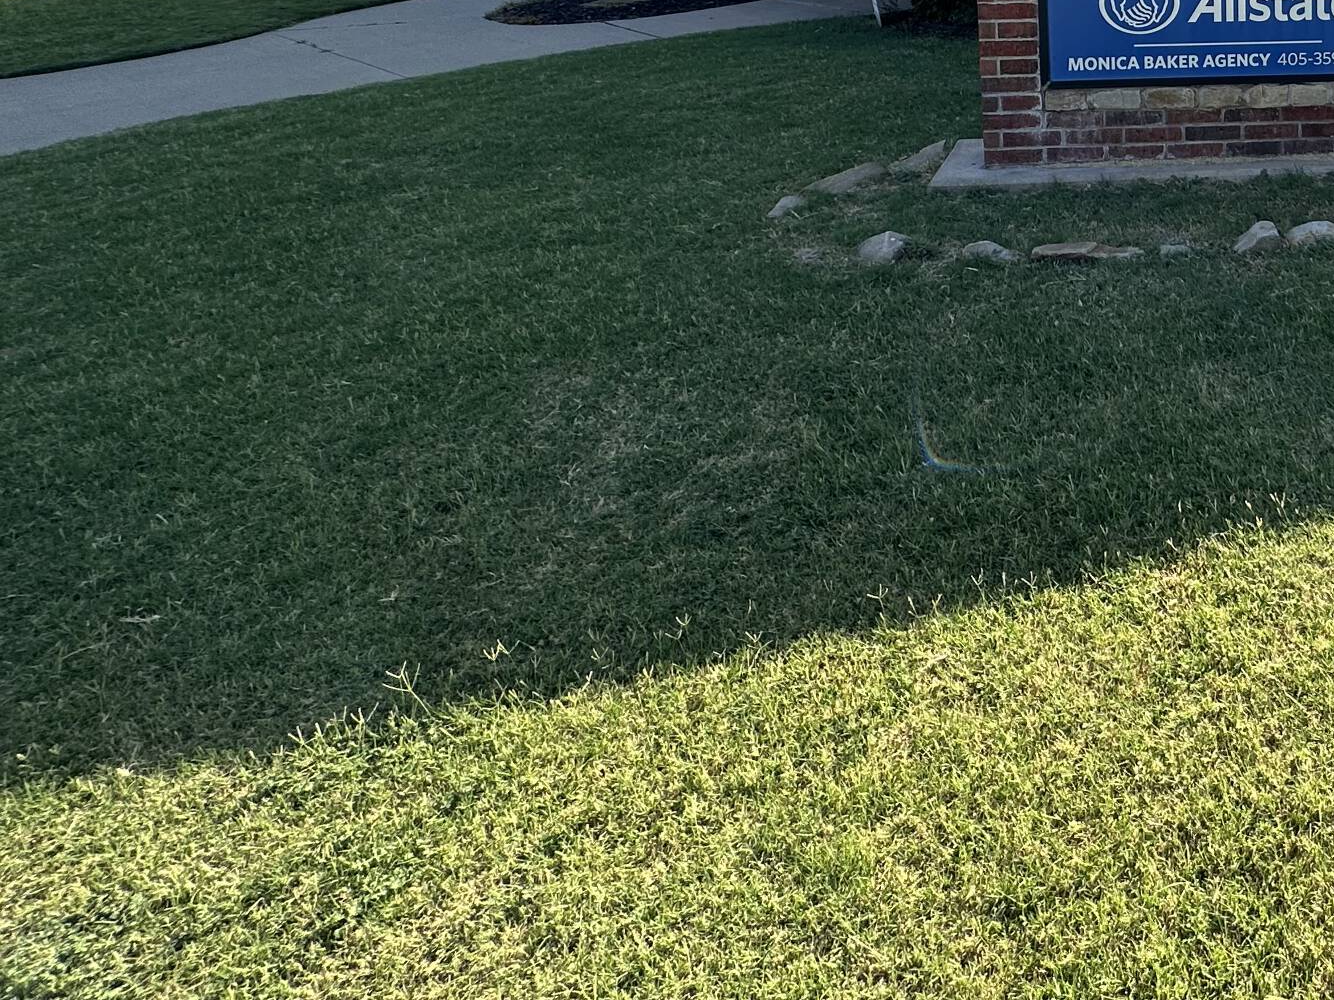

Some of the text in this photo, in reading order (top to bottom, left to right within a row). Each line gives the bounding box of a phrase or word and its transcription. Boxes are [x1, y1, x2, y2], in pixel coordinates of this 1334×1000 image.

[1068, 55, 1139, 71] MONICA
[1144, 54, 1199, 70] BAKER
[1202, 52, 1272, 68] AGENCY
